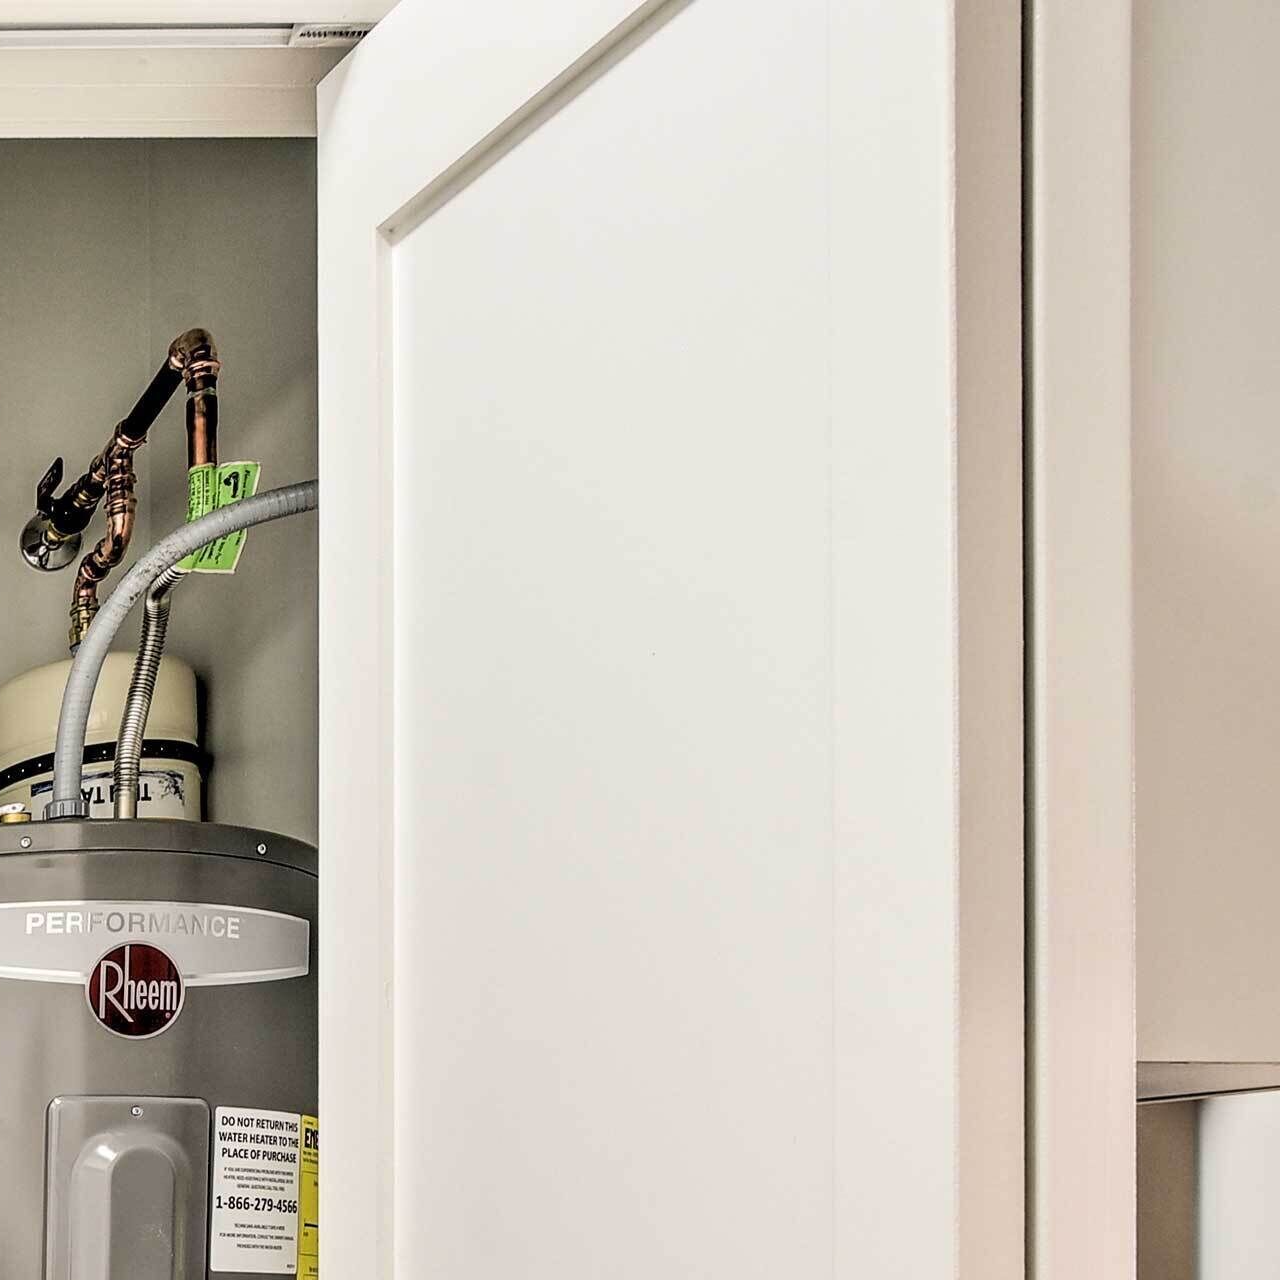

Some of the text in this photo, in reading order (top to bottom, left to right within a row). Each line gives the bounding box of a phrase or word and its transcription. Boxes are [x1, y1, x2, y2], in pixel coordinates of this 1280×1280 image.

[26, 911, 240, 939] PERFORMANCE
[99, 945, 178, 1023] Rheem
[221, 1116, 298, 1132] DO NOT RETURN THIS
[219, 1131, 299, 1148] WATER HEATER TO THE
[222, 1147, 248, 1158] PLACE
[250, 1149, 260, 1160] OF
[262, 1150, 296, 1163] PURCHASE
[216, 1194, 298, 1214] 1-866-279-4566
